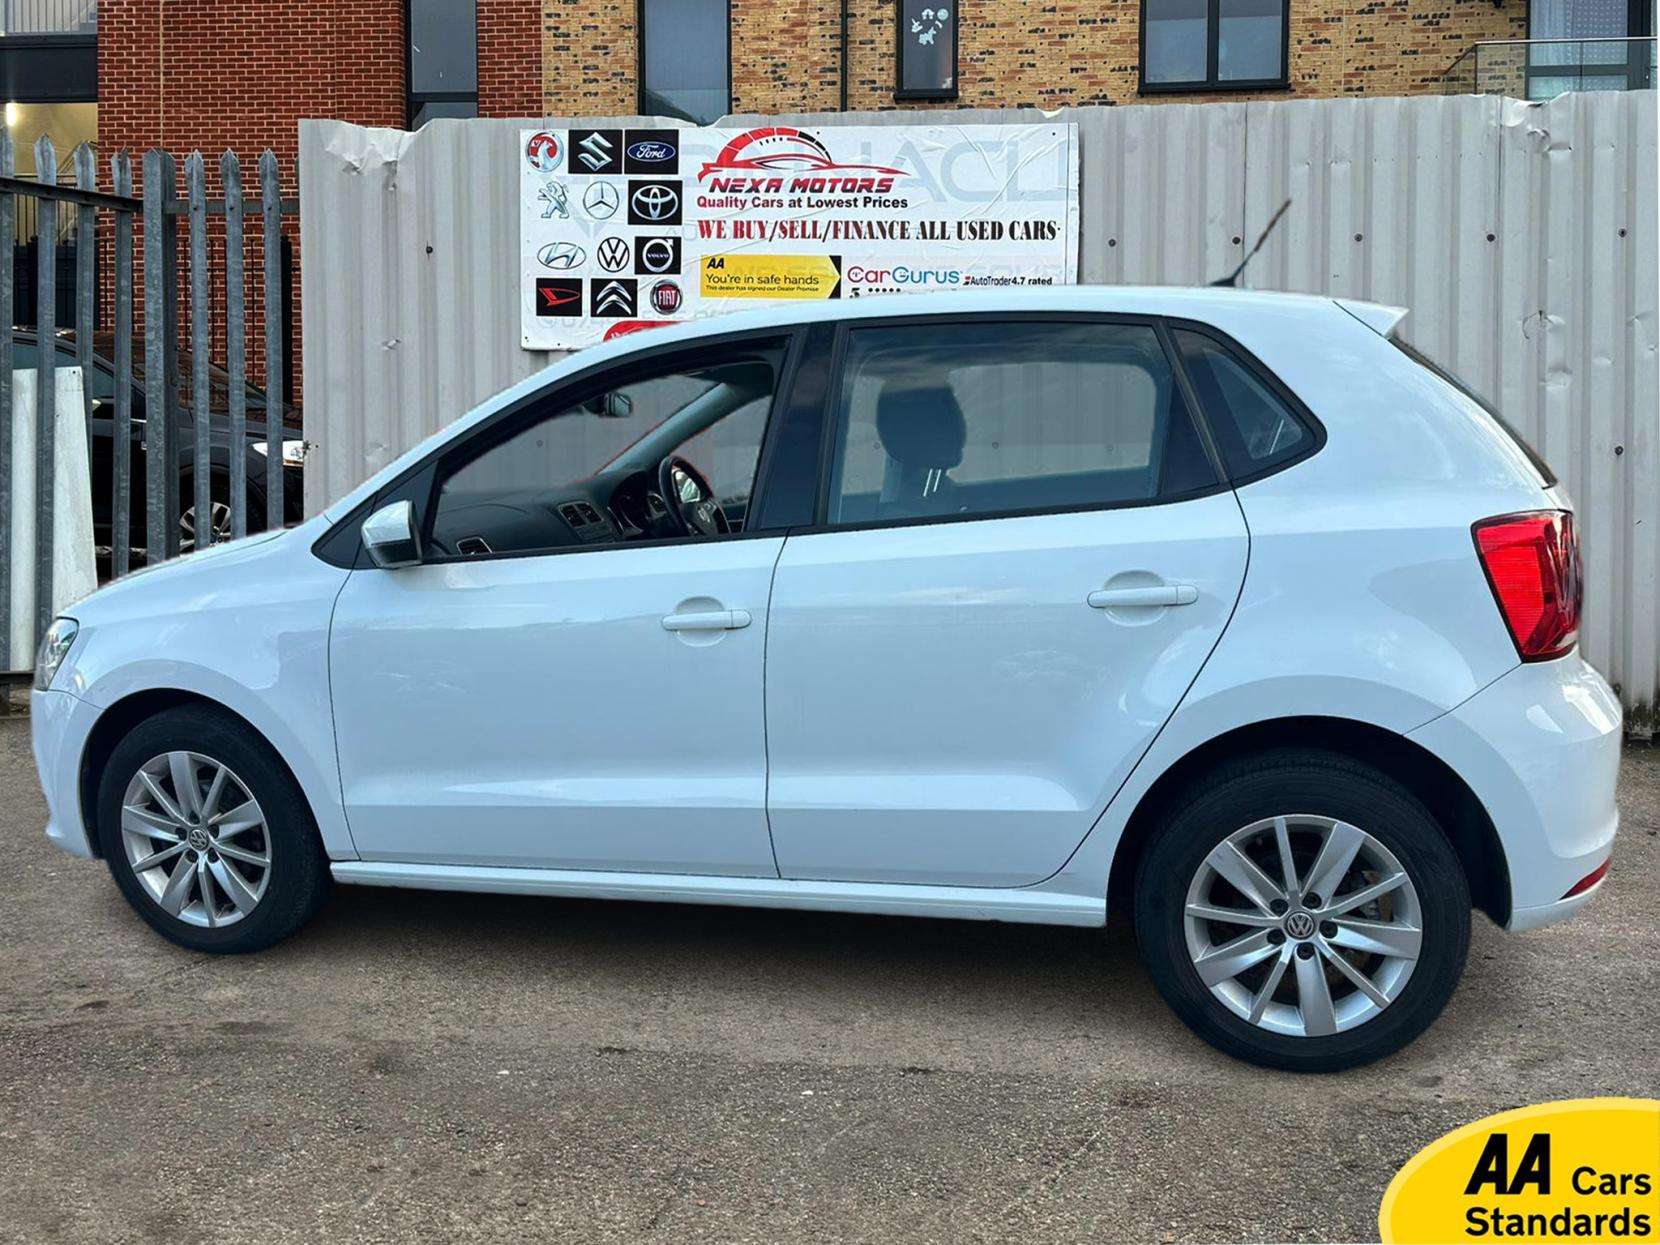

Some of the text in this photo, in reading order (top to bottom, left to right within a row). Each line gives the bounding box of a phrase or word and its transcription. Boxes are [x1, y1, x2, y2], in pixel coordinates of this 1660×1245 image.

[636, 143, 667, 159] Ford
[708, 177, 895, 194] NEXA MOTORS
[697, 195, 909, 211] Quality Cars at Lowest Prices
[697, 220, 727, 240] WE
[916, 220, 951, 240] ALL
[956, 220, 1004, 240] USED
[706, 257, 725, 269] AA
[705, 273, 820, 285] You're in safe hands
[847, 265, 960, 284] CarGurus
[1028, 276, 1053, 285] rated
[657, 290, 677, 306] FIAT
